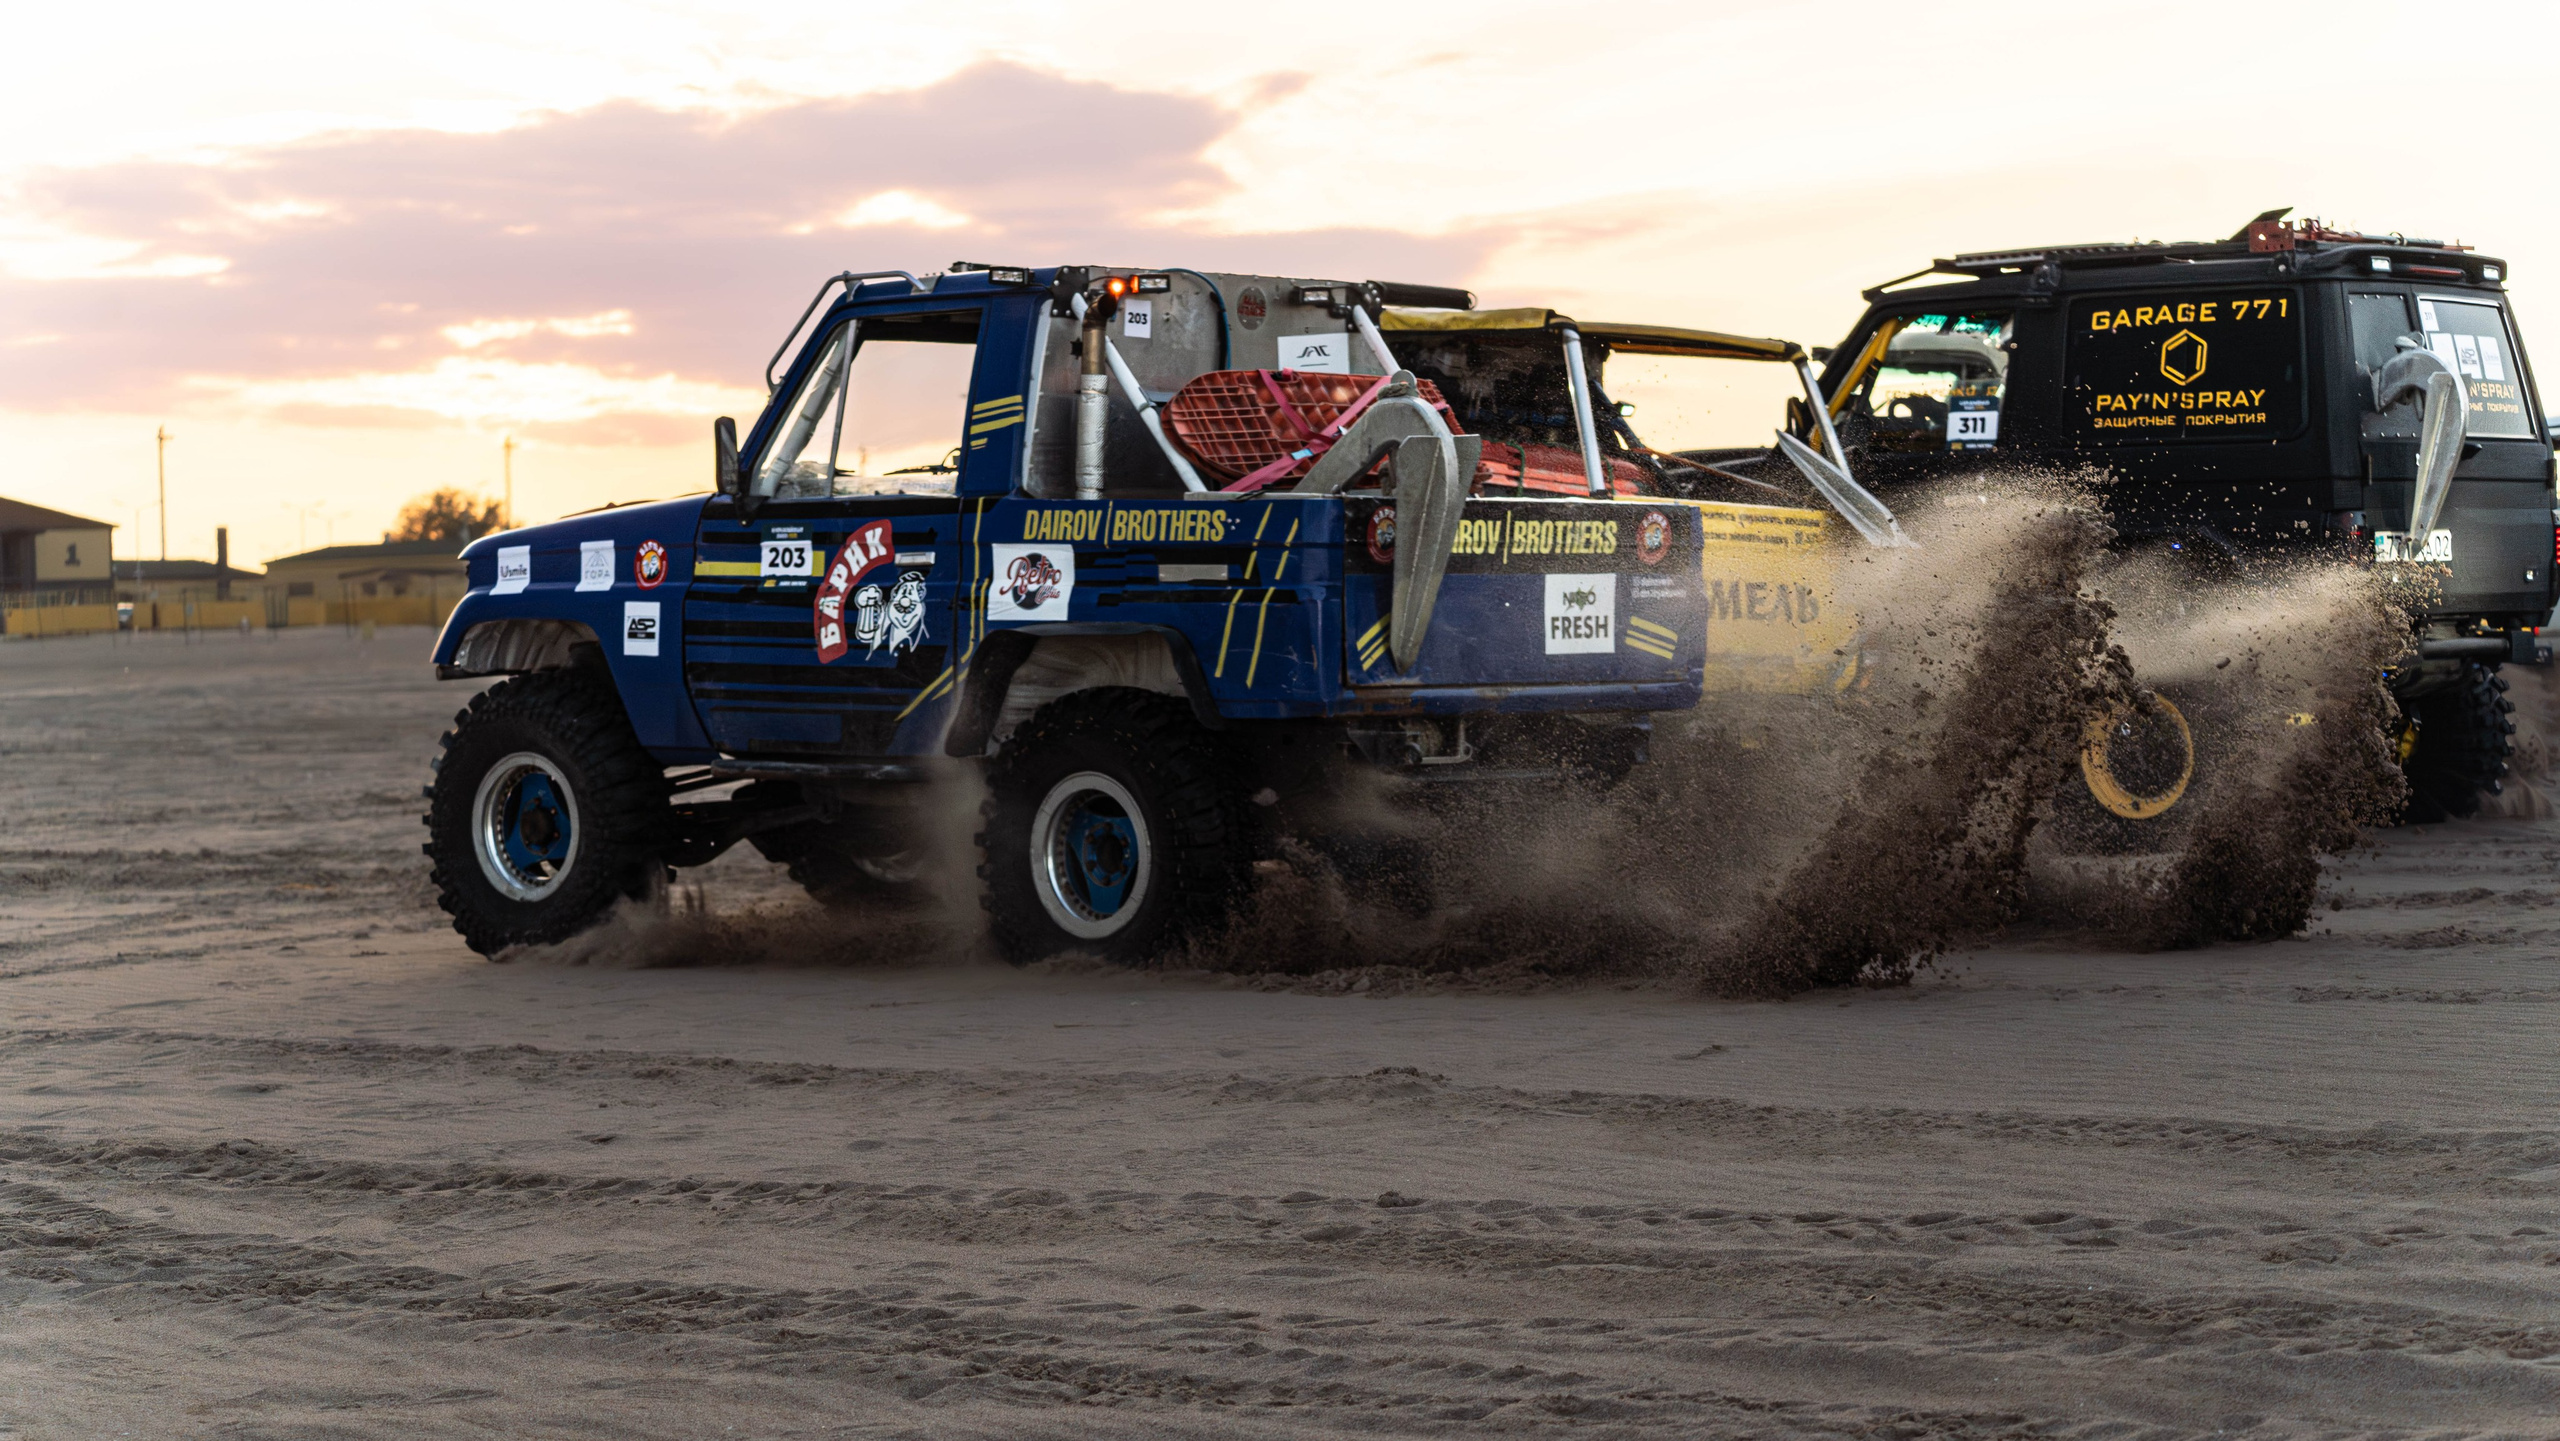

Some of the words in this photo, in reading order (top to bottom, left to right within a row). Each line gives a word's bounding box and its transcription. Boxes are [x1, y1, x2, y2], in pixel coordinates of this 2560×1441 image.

[1127, 312, 1149, 325] 203
[2091, 302, 2218, 331] GARAGE
[2231, 298, 2288, 321] 771
[2095, 388, 2266, 412] PAY'N'SPRAY
[1958, 416, 1986, 434] 311
[2093, 414, 2177, 429] ЗАЩИТНЫЕ
[2185, 412, 2266, 426] ПОКРЫТИЯ
[1023, 509, 1102, 541] DAIROV
[1111, 509, 1228, 542] BROTHERS
[1511, 520, 1619, 555] BROTHERS
[768, 546, 806, 569] 203
[819, 526, 888, 650] БАРИК
[999, 555, 1062, 596] Retro
[627, 617, 657, 632] ASP
[1550, 614, 1609, 640] FRESH
